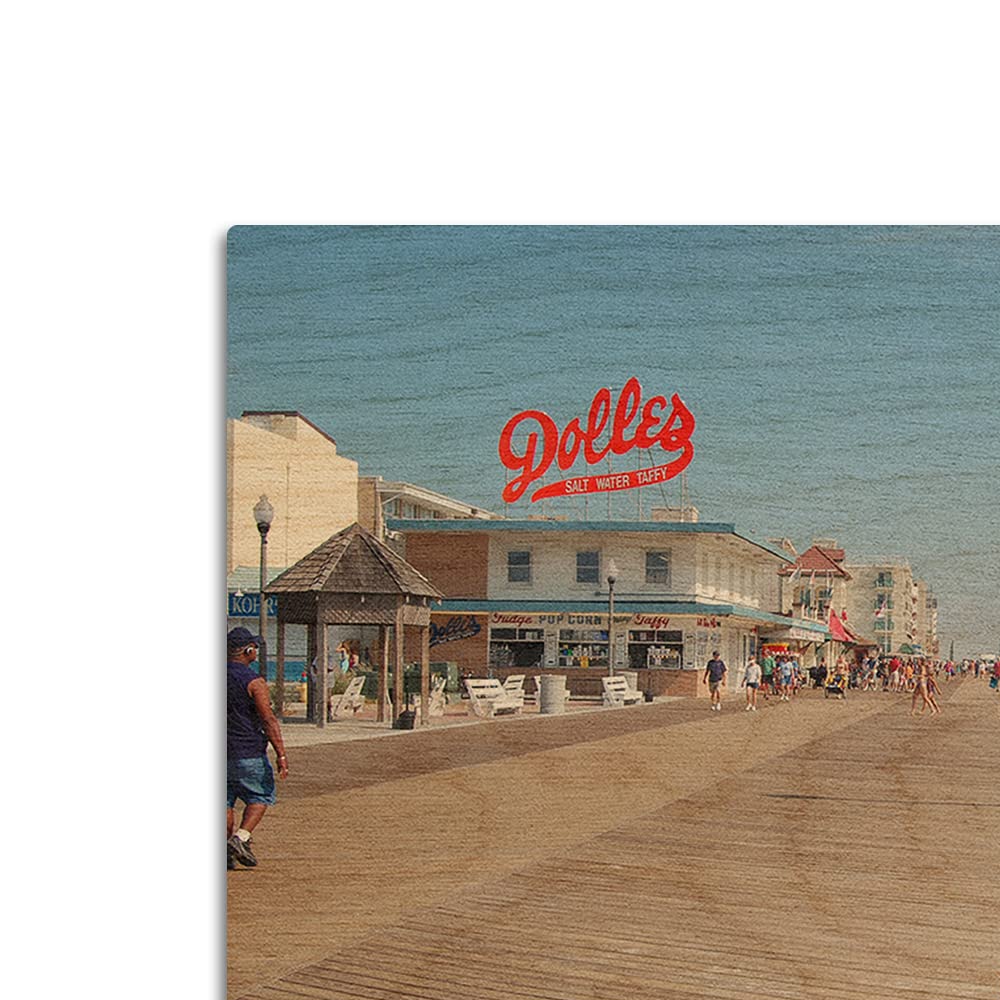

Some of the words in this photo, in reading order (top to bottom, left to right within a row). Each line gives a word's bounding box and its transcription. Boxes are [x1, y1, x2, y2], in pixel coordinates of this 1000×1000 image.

[565, 479, 589, 493] SALT
[596, 475, 630, 489] WATER
[636, 467, 668, 484] TAFFY
[492, 613, 533, 627] Fudge
[634, 614, 670, 629] Taffy
